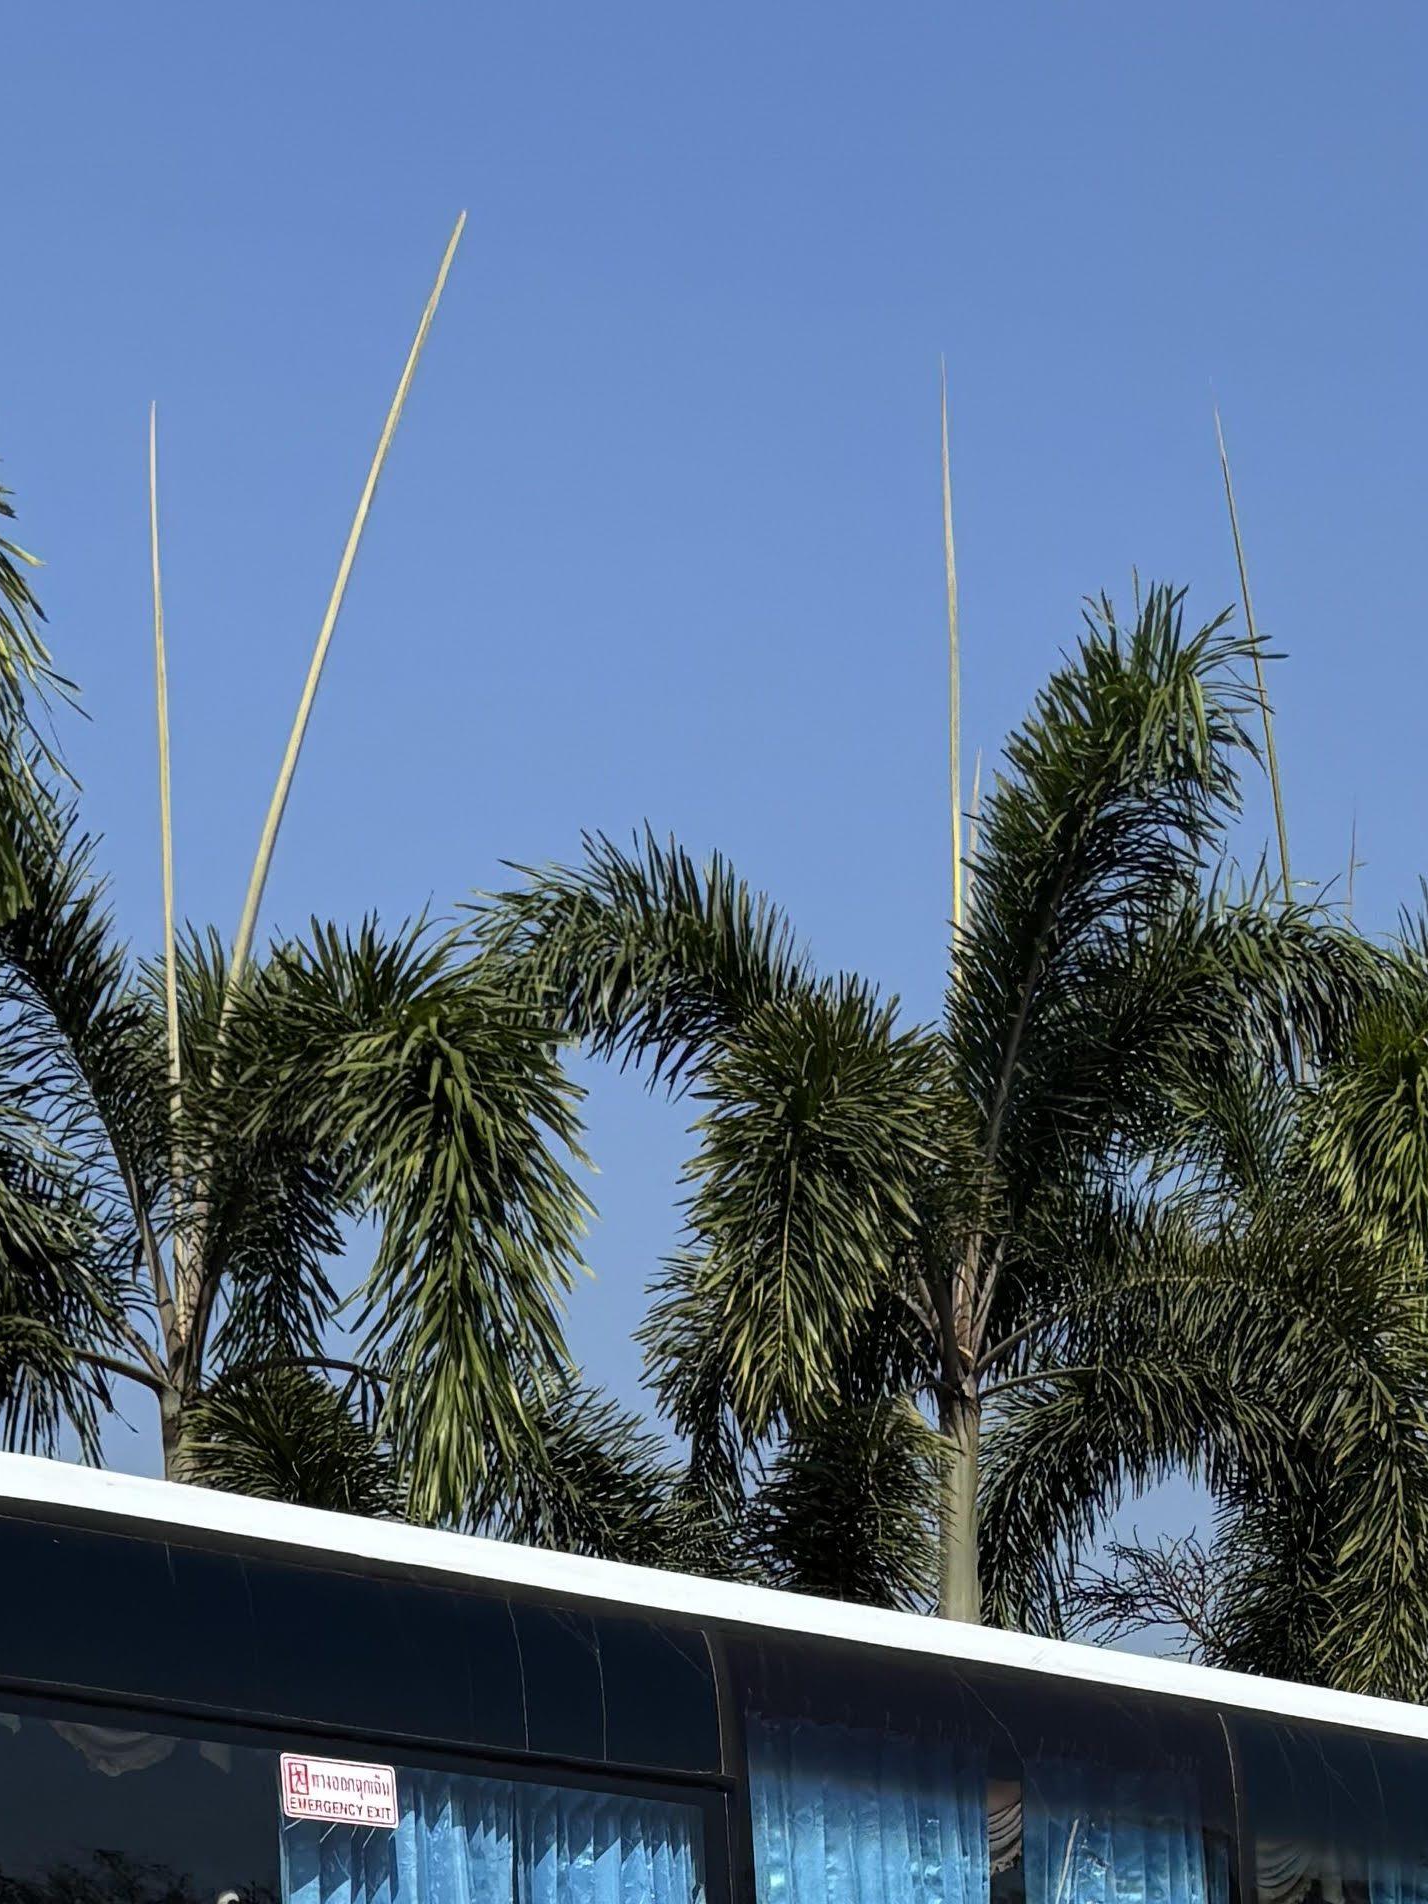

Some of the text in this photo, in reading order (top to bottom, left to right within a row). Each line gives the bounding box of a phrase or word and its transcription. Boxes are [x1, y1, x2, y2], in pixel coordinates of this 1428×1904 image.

[311, 1774, 390, 1800] ทางออกฉุกเฉิน
[290, 1797, 392, 1821] EMERGENCY EXIT
